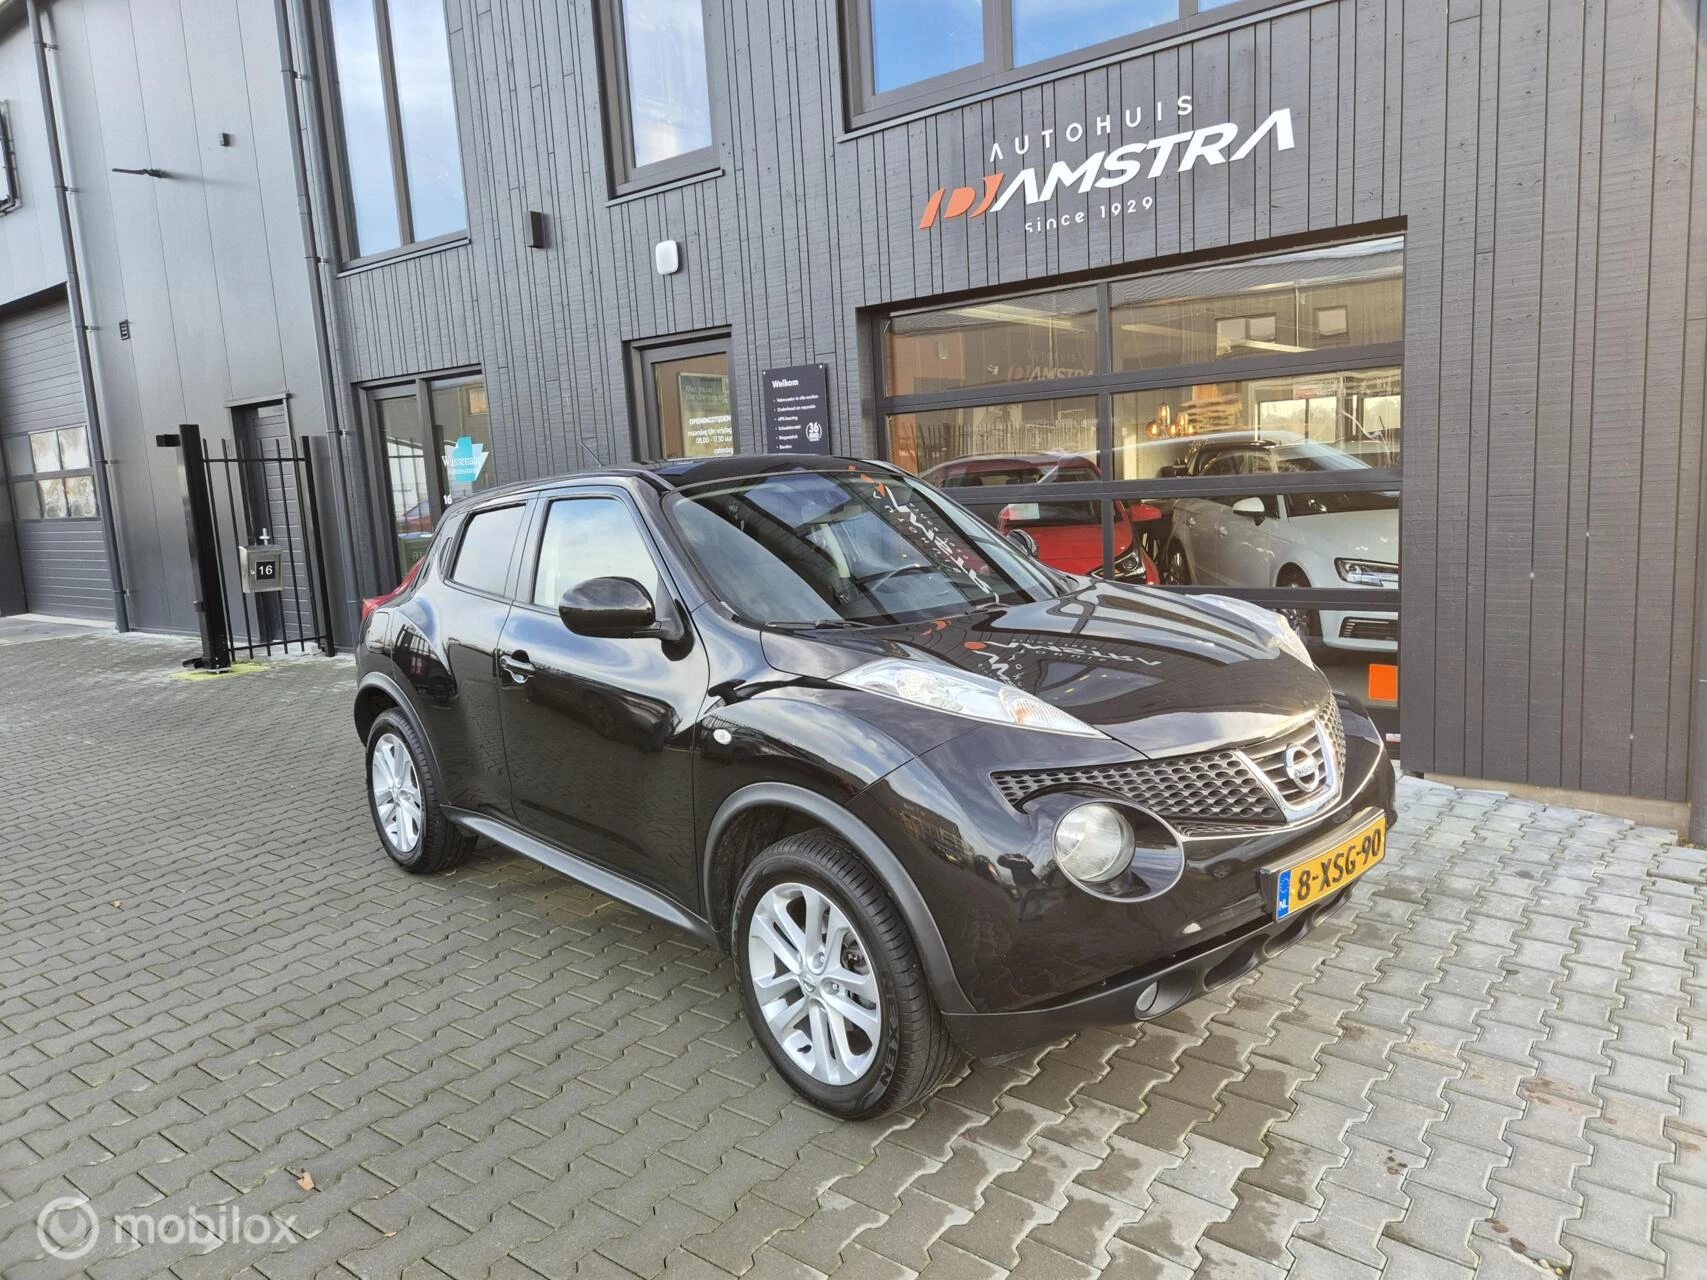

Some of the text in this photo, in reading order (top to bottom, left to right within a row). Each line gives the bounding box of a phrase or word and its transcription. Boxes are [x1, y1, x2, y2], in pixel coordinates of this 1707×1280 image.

[989, 95, 1193, 163] AUTOHUIS
[1024, 196, 1154, 234] since 1929
[772, 379, 799, 388] Welkom
[808, 422, 819, 433] 36
[443, 494, 453, 505] 16
[259, 565, 273, 575] 16
[1296, 828, 1381, 901] 8-XSG-90
[1279, 898, 1288, 910] NL
